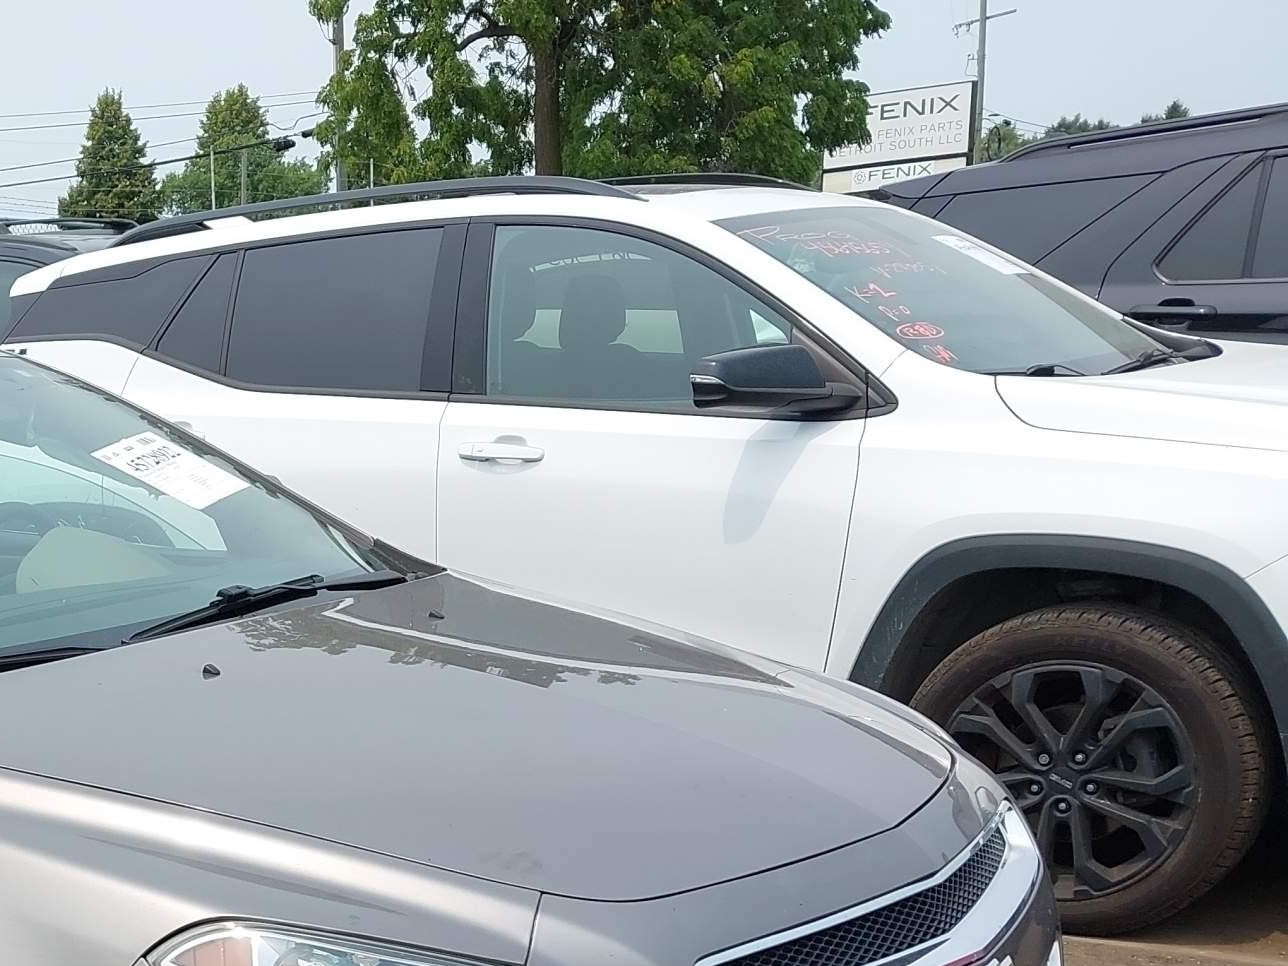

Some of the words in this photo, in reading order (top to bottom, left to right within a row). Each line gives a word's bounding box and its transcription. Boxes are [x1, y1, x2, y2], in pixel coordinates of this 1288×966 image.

[877, 127, 915, 141] FENIX
[919, 120, 963, 134] PARTS
[888, 138, 933, 151] SOUTH
[868, 163, 932, 182] FENIX
